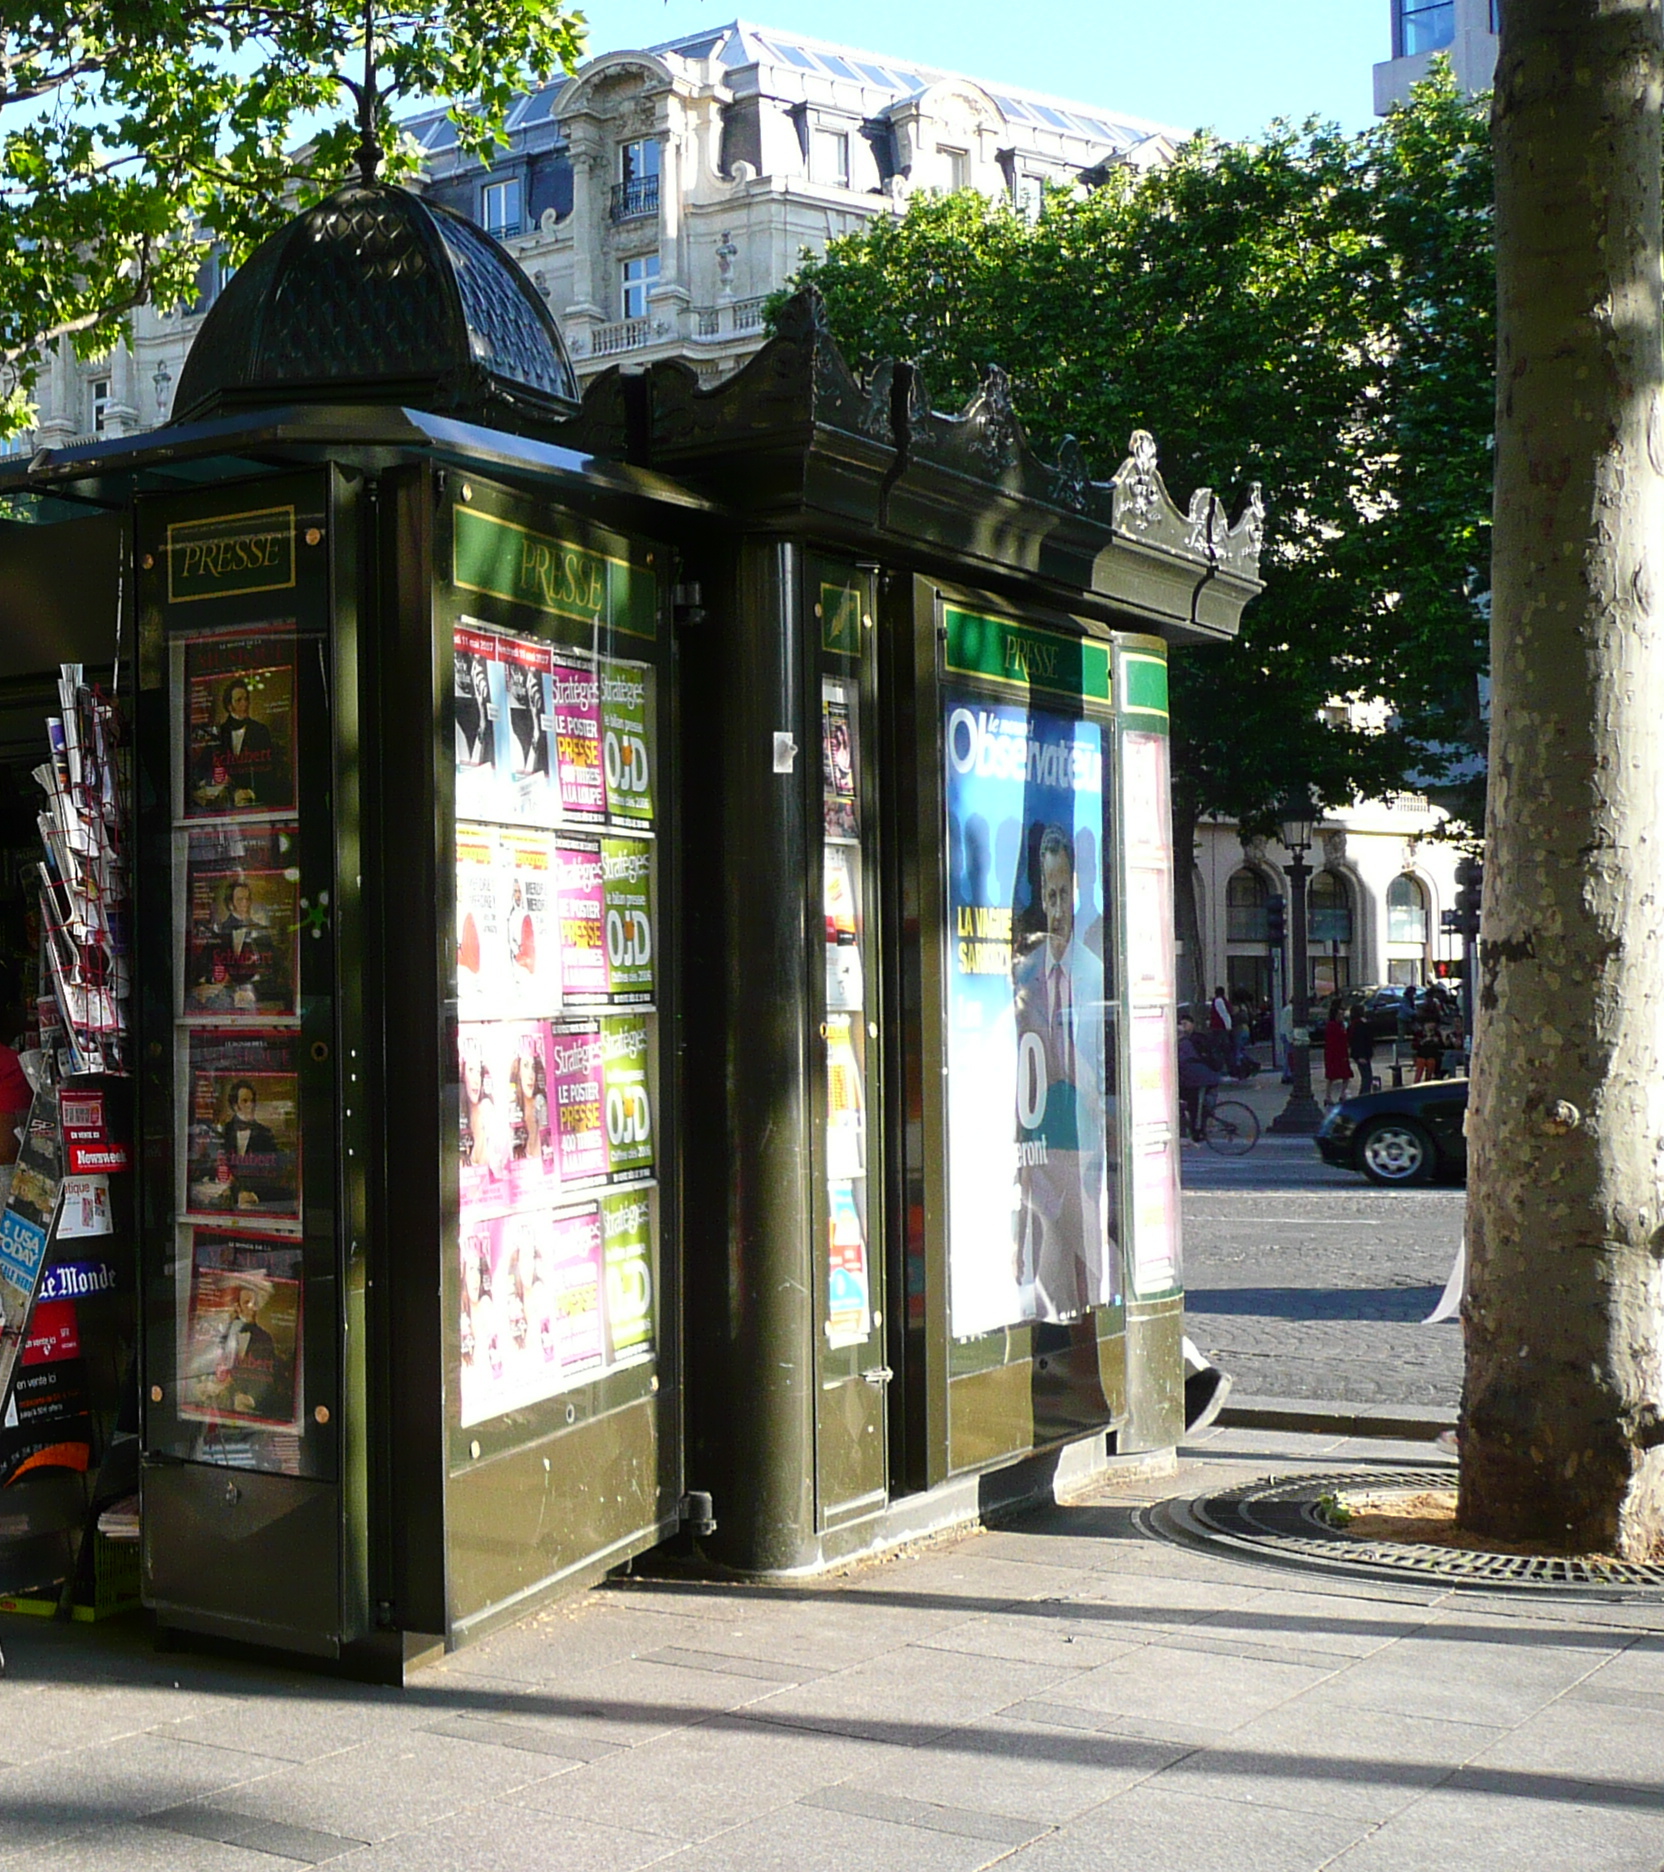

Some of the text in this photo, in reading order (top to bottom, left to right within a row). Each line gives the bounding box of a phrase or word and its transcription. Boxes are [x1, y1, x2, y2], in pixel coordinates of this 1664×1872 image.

[182, 534, 281, 577] PRESSE
[522, 539, 602, 610] PRESSE
[1005, 635, 1059, 681] PRESSE
[555, 715, 566, 734] LE
[567, 717, 598, 738] POSTER
[557, 736, 599, 766] PRESSE
[604, 731, 648, 792] OJD
[601, 848, 649, 883] Stratégies
[607, 910, 651, 966] OJD
[958, 906, 974, 937] LA
[570, 1082, 599, 1102] POSTER
[560, 1104, 600, 1132] PRESSE
[606, 1085, 650, 1145] OJD
[77, 1149, 127, 1165] Newsweek
[14, 1225, 39, 1254] USA
[39, 1263, 117, 1299] Le Monde
[27, 1376, 47, 1387] vente
